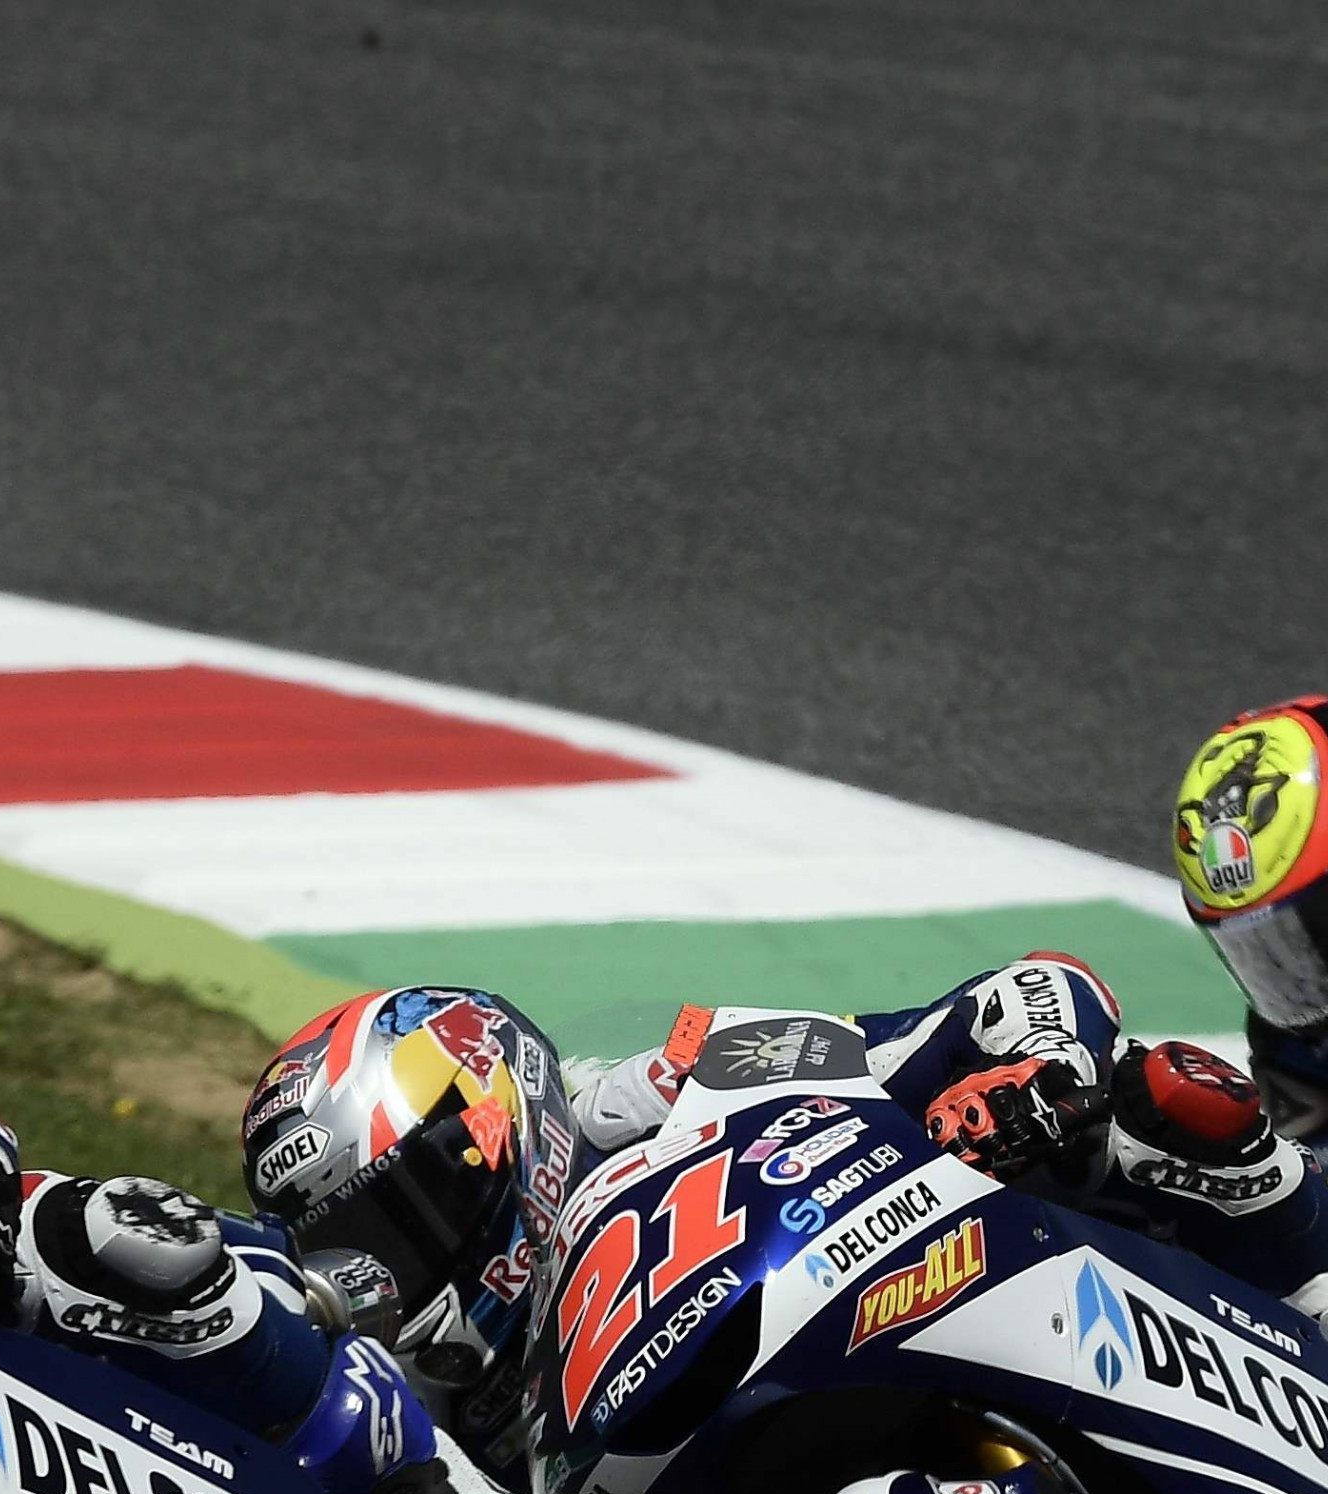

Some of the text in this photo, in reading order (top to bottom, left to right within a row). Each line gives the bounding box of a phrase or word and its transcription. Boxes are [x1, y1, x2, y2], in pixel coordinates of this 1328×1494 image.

[270, 1075, 309, 1115] Bull
[260, 1131, 318, 1188] SHOEI
[335, 1146, 403, 1200] WINGS
[529, 1111, 573, 1211] Bull
[812, 1143, 903, 1208] SAGTUBI
[558, 1147, 746, 1433] 21
[862, 1220, 983, 1335] YOU-ALL
[605, 1266, 743, 1411] FASTDESIGN
[1209, 1294, 1303, 1358] TEAM
[124, 1407, 235, 1481] TEAM
